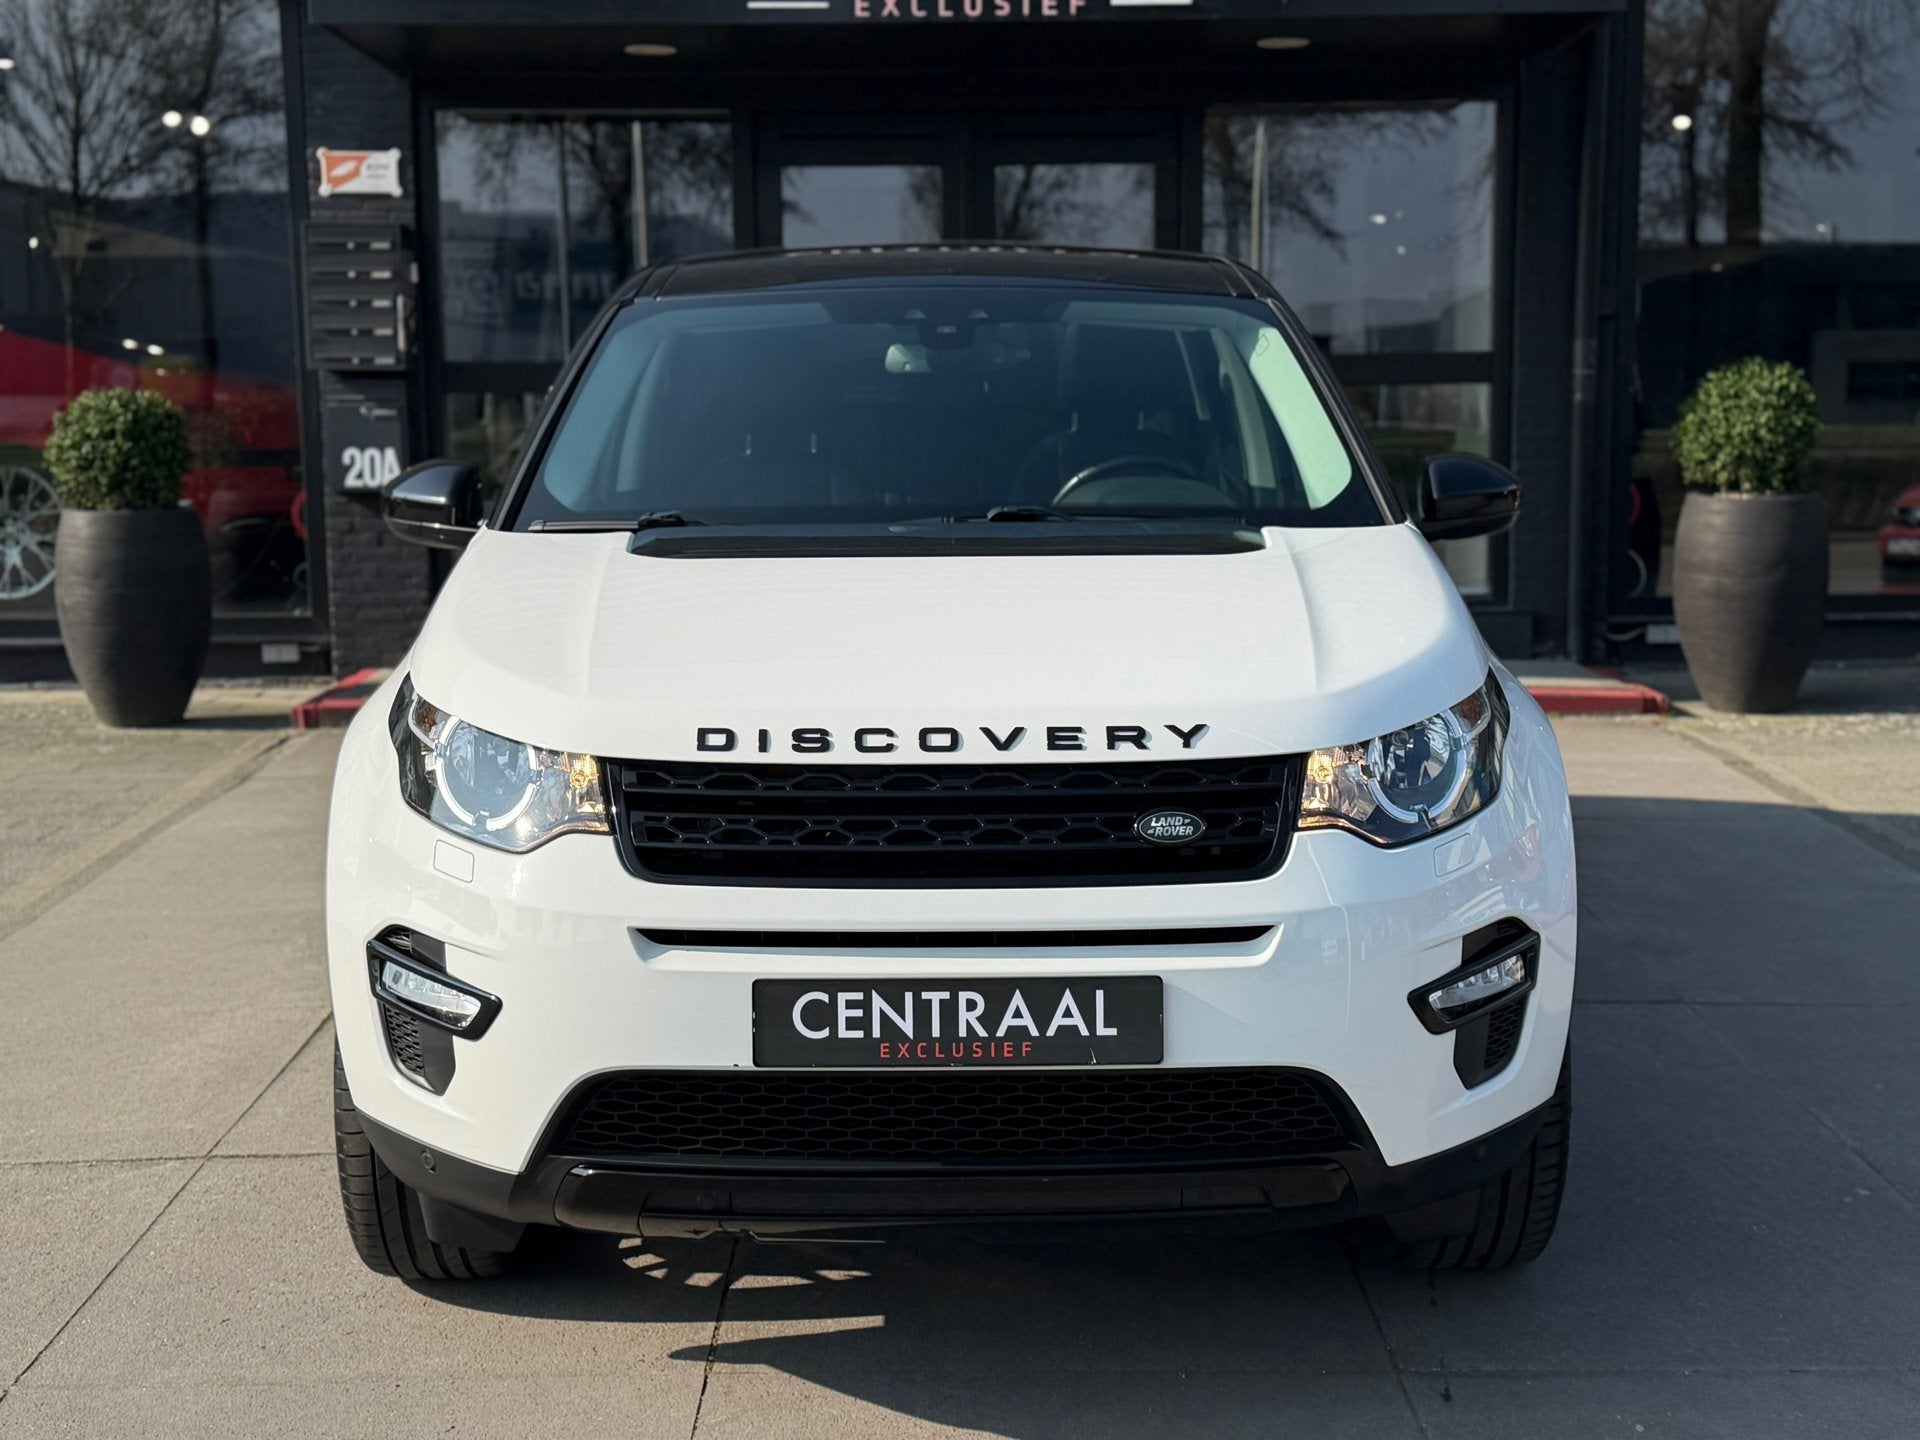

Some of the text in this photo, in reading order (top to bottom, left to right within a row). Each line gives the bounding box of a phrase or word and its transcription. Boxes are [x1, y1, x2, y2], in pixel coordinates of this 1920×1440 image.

[341, 446, 402, 488] 20A
[696, 723, 1211, 753] DISCOVERY
[1151, 816, 1183, 827] LAND
[1154, 826, 1194, 837] ROVER
[792, 988, 1117, 1040] CENTRAAL
[880, 1041, 1034, 1060] EXCLUSIEF
